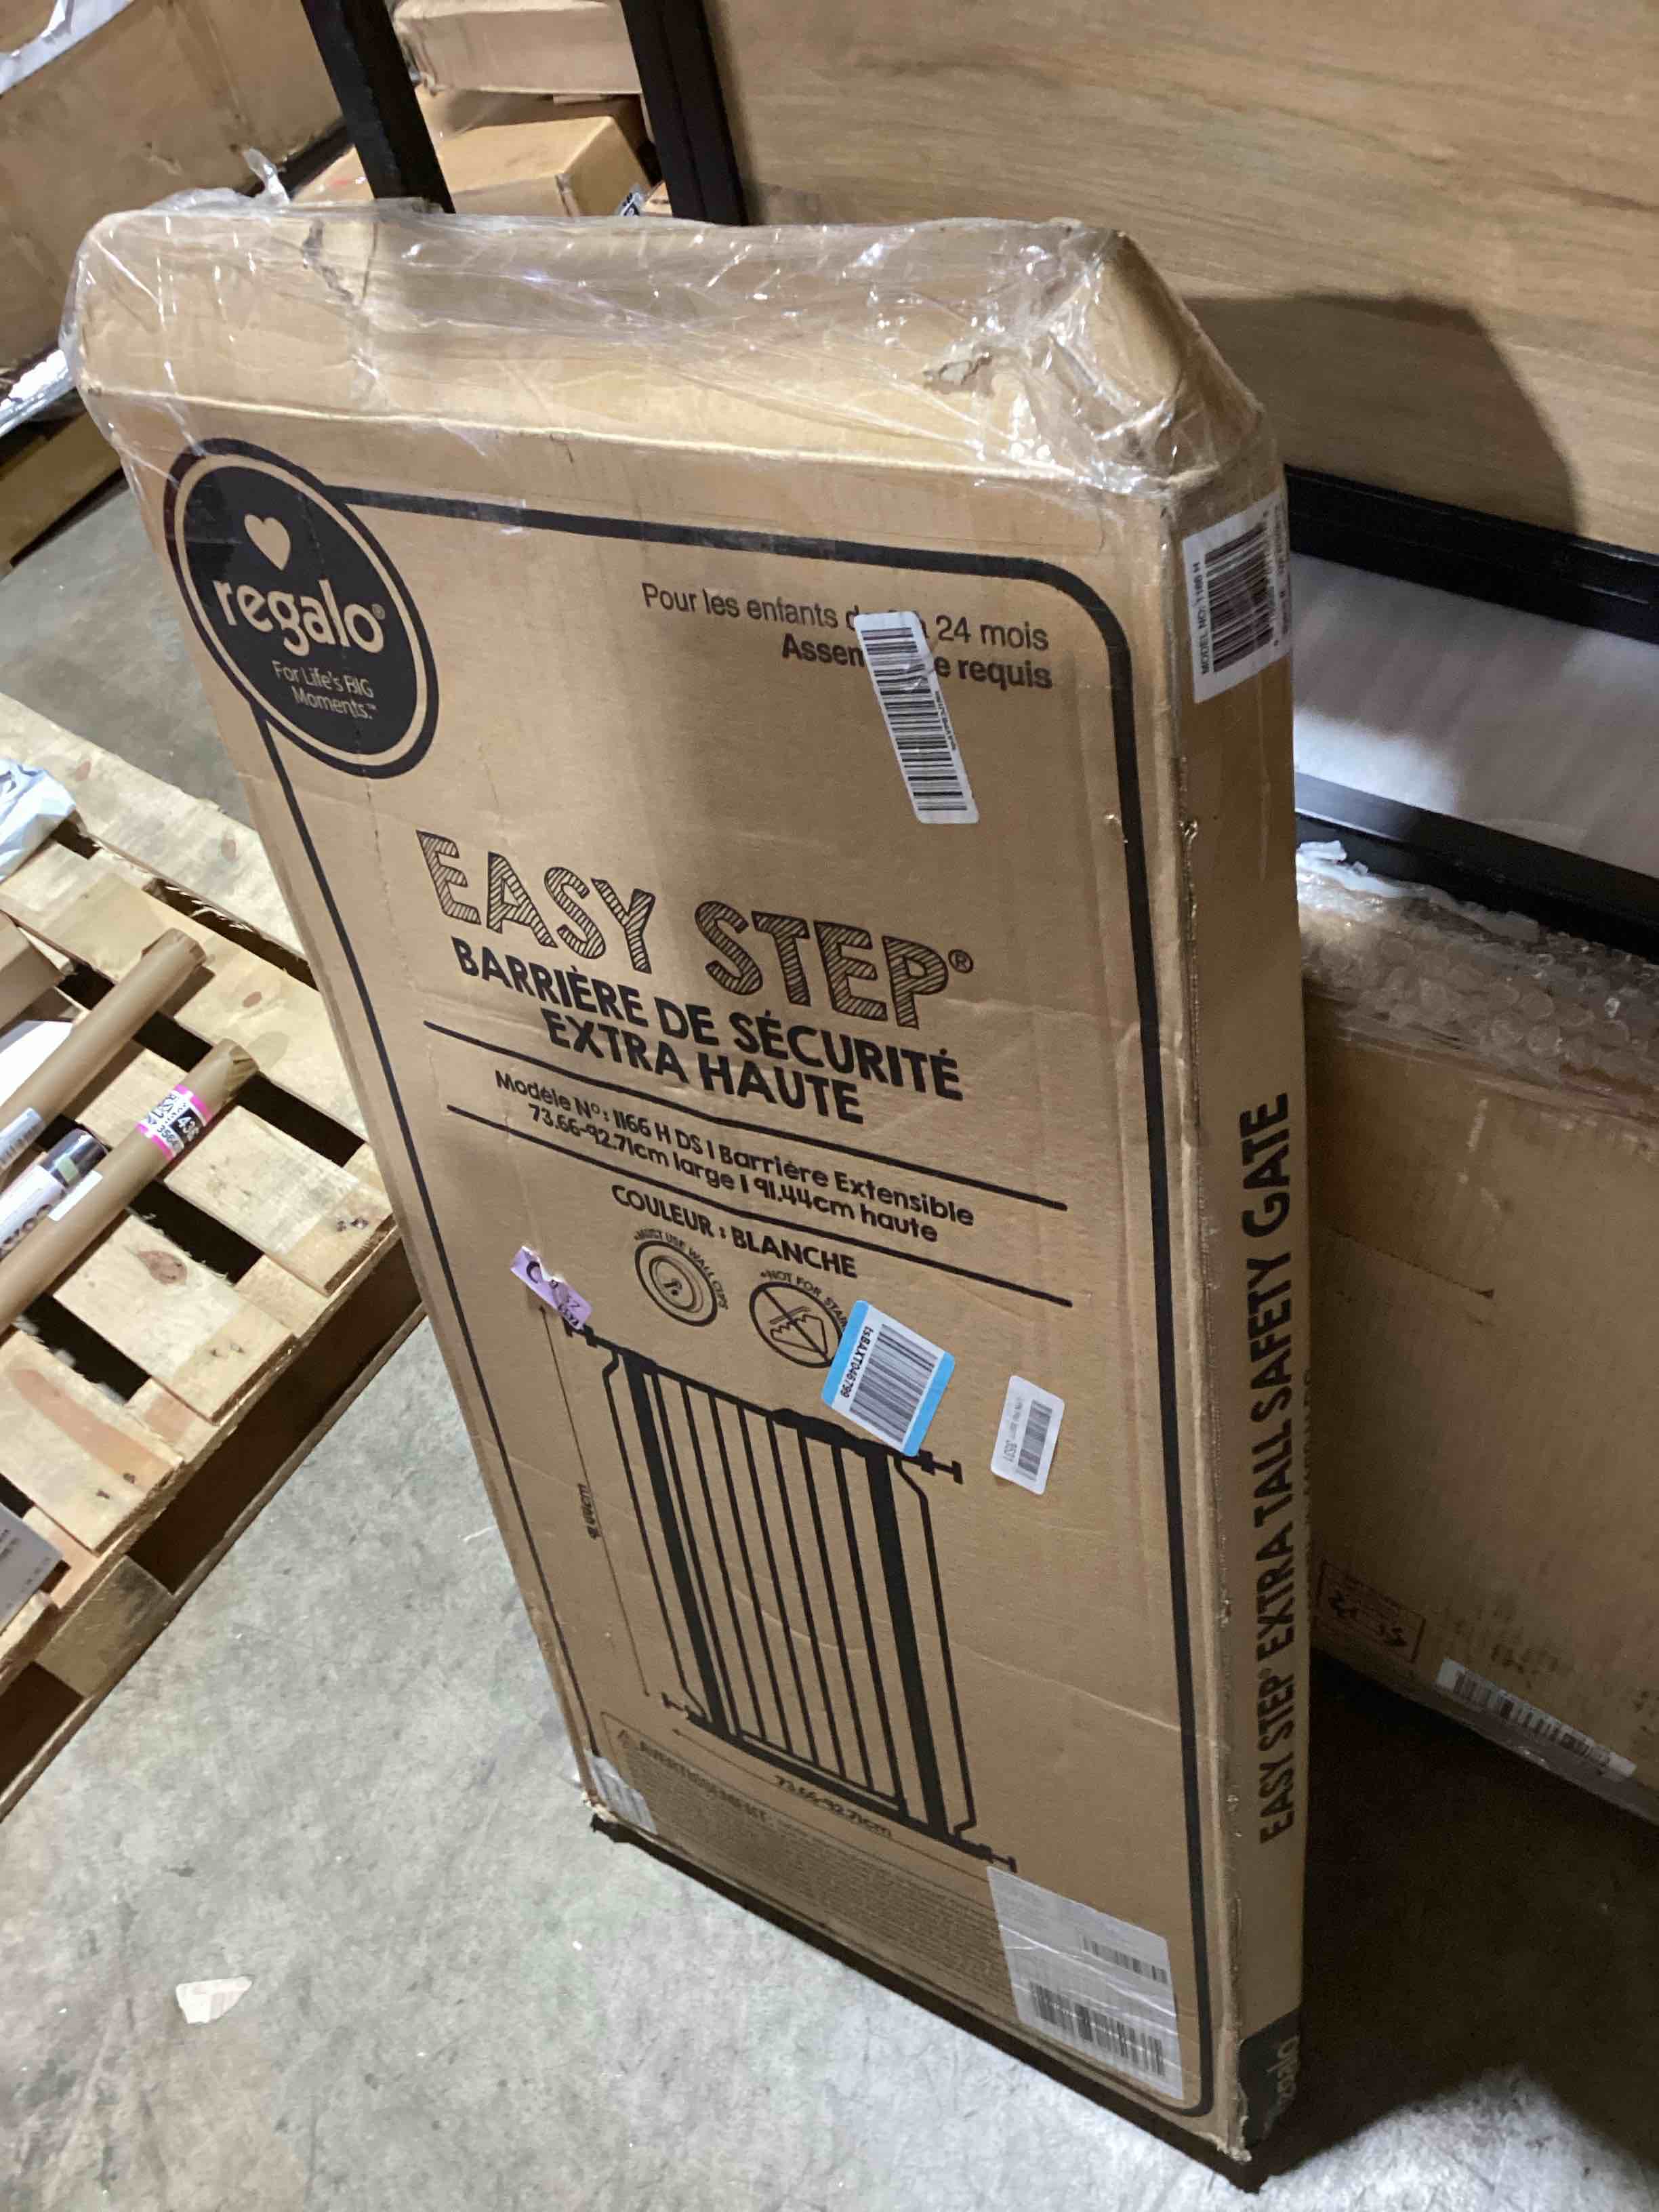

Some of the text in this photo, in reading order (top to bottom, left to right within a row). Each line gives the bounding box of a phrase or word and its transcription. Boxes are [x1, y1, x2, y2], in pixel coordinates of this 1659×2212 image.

[641, 583, 697, 613] Pour
[703, 588, 739, 617] les
[747, 597, 839, 629] enfants
[936, 615, 971, 643] 24
[980, 621, 1049, 651] mois
[957, 659, 1053, 691] requis
[272, 659, 374, 697] For Life's BIG
[416, 829, 655, 975] EASY
[451, 935, 964, 1101] BARRIÈRE DE SÉCURITÉ
[540, 1006, 864, 1124] EXTRA HAUTE
[528, 1103, 669, 1167] 73.66-92.71cm
[673, 1151, 735, 1191] large
[754, 1177, 855, 1220] 91.44cm
[860, 1203, 937, 1242] haute
[613, 1109, 651, 1138] 1166
[654, 1122, 672, 1144] H
[675, 1128, 703, 1155] DS
[718, 1144, 829, 1187] Barrière
[834, 1171, 974, 1226] Extensible
[1240, 1092, 1290, 1238] GATE
[611, 1185, 715, 1237] COULEUR
[731, 1225, 857, 1278] BLANCHE
[796, 1275, 822, 1297] FOR
[1247, 1252, 1292, 1422] SAFETY
[1252, 1418, 1292, 1528] TALL
[1256, 1521, 1294, 1662] EXTRA
[1259, 1750, 1294, 1843] EASY
